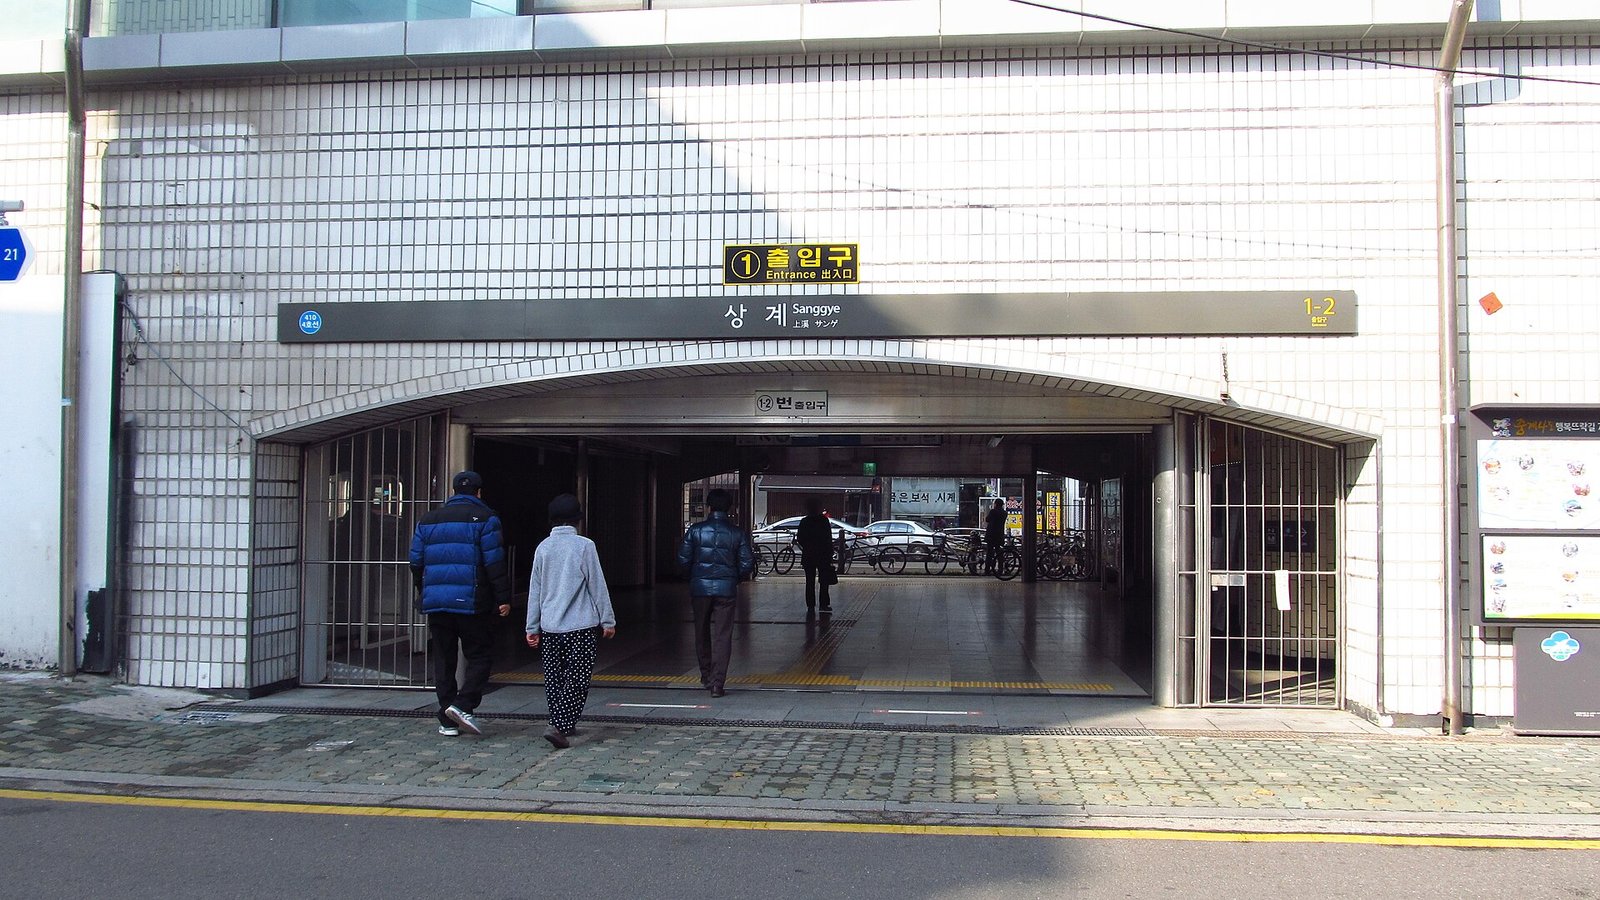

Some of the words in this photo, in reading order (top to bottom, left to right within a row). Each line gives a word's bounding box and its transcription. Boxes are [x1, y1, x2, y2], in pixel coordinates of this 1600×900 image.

[4, 248, 18, 261] 21
[766, 247, 852, 268] 출입구
[766, 270, 816, 280] Entrance
[821, 269, 852, 280] 出入口
[792, 303, 841, 317] Sanggye
[1303, 297, 1336, 315] 1-2
[776, 396, 792, 410] 번
[794, 401, 826, 410] 출입구
